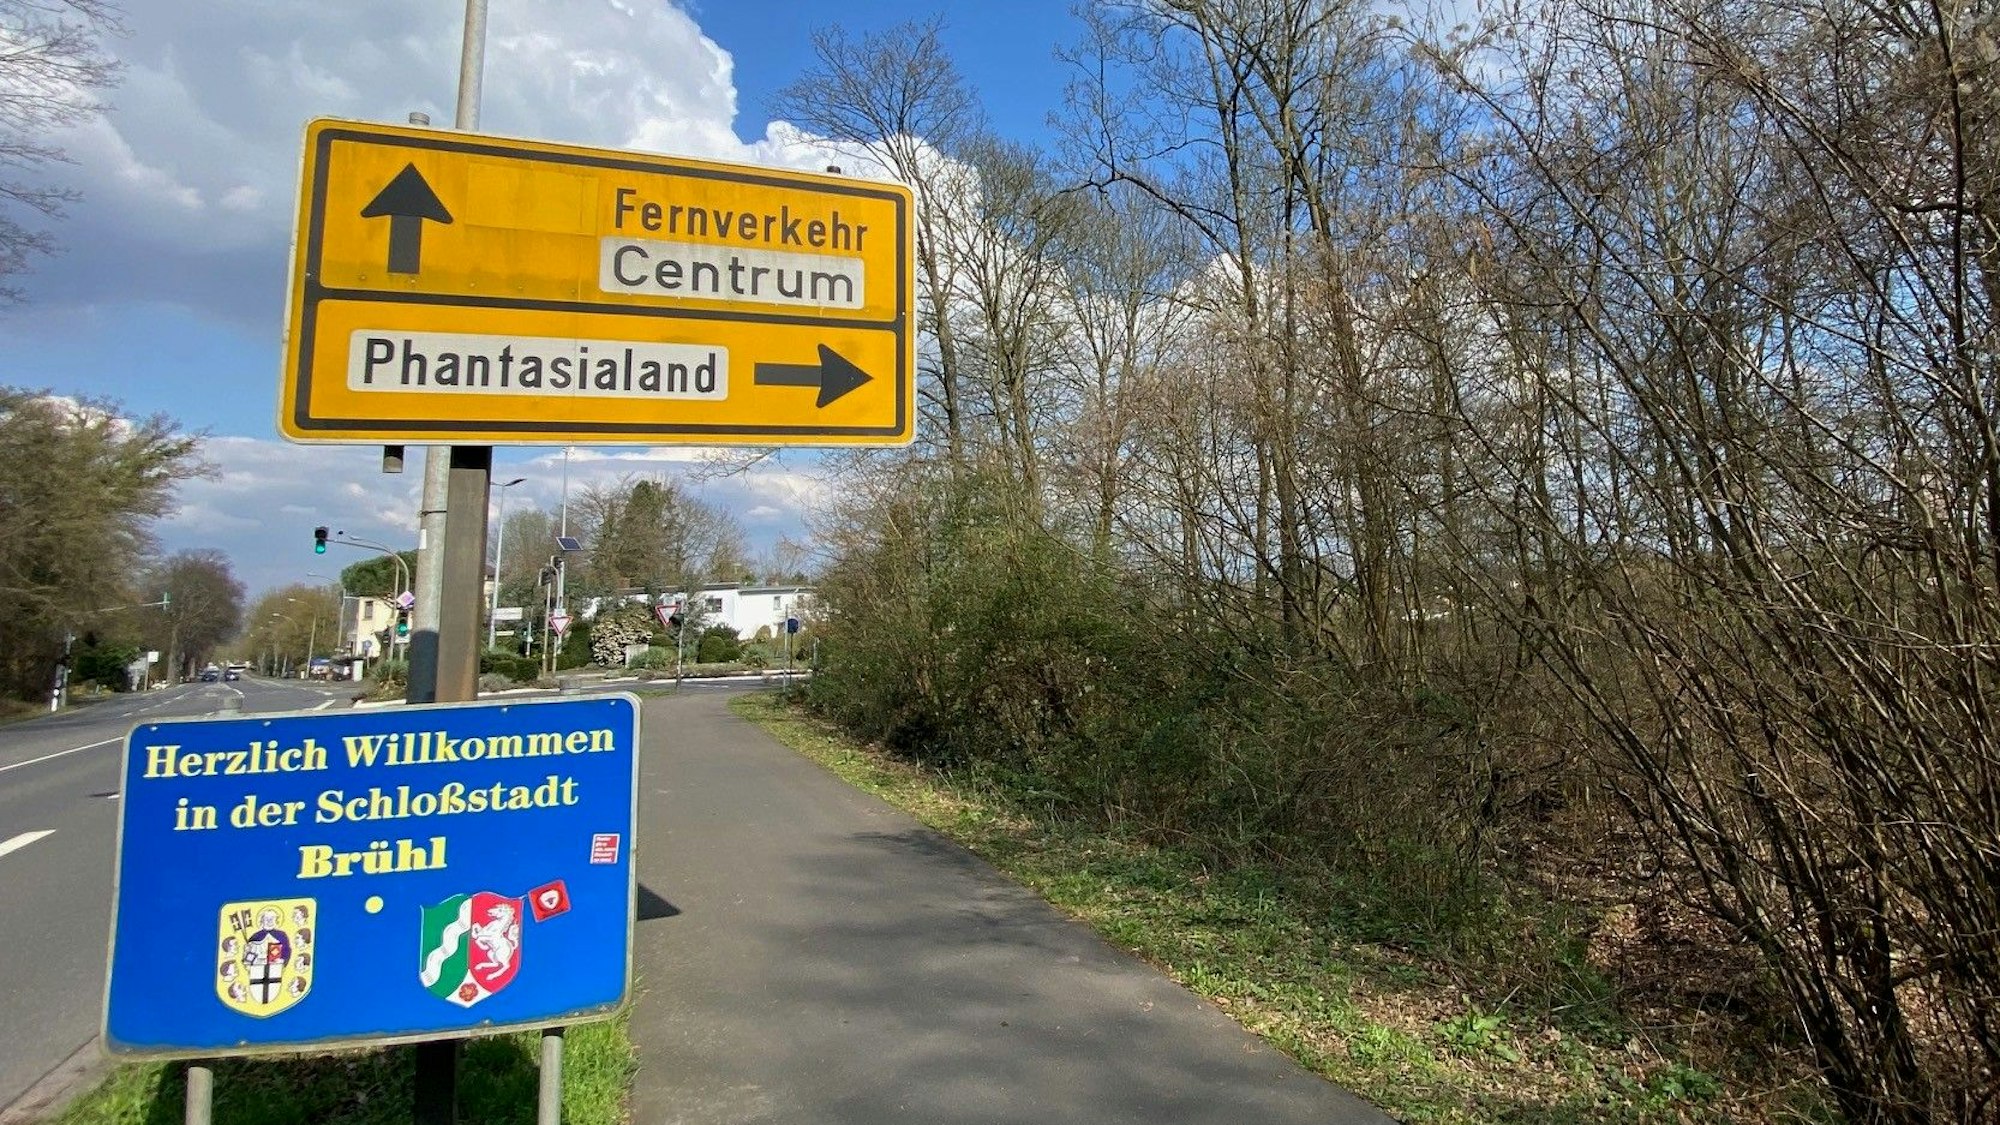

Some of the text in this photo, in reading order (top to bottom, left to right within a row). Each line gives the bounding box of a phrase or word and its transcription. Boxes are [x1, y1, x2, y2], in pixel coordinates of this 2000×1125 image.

[614, 187, 868, 252] Fernverkehr
[613, 244, 854, 302] Centrum
[363, 337, 716, 395] Phantasialand
[143, 728, 616, 778] Herzlich Willkommen
[174, 775, 580, 831] in der Schloßstadt
[296, 836, 448, 879] Brühl
